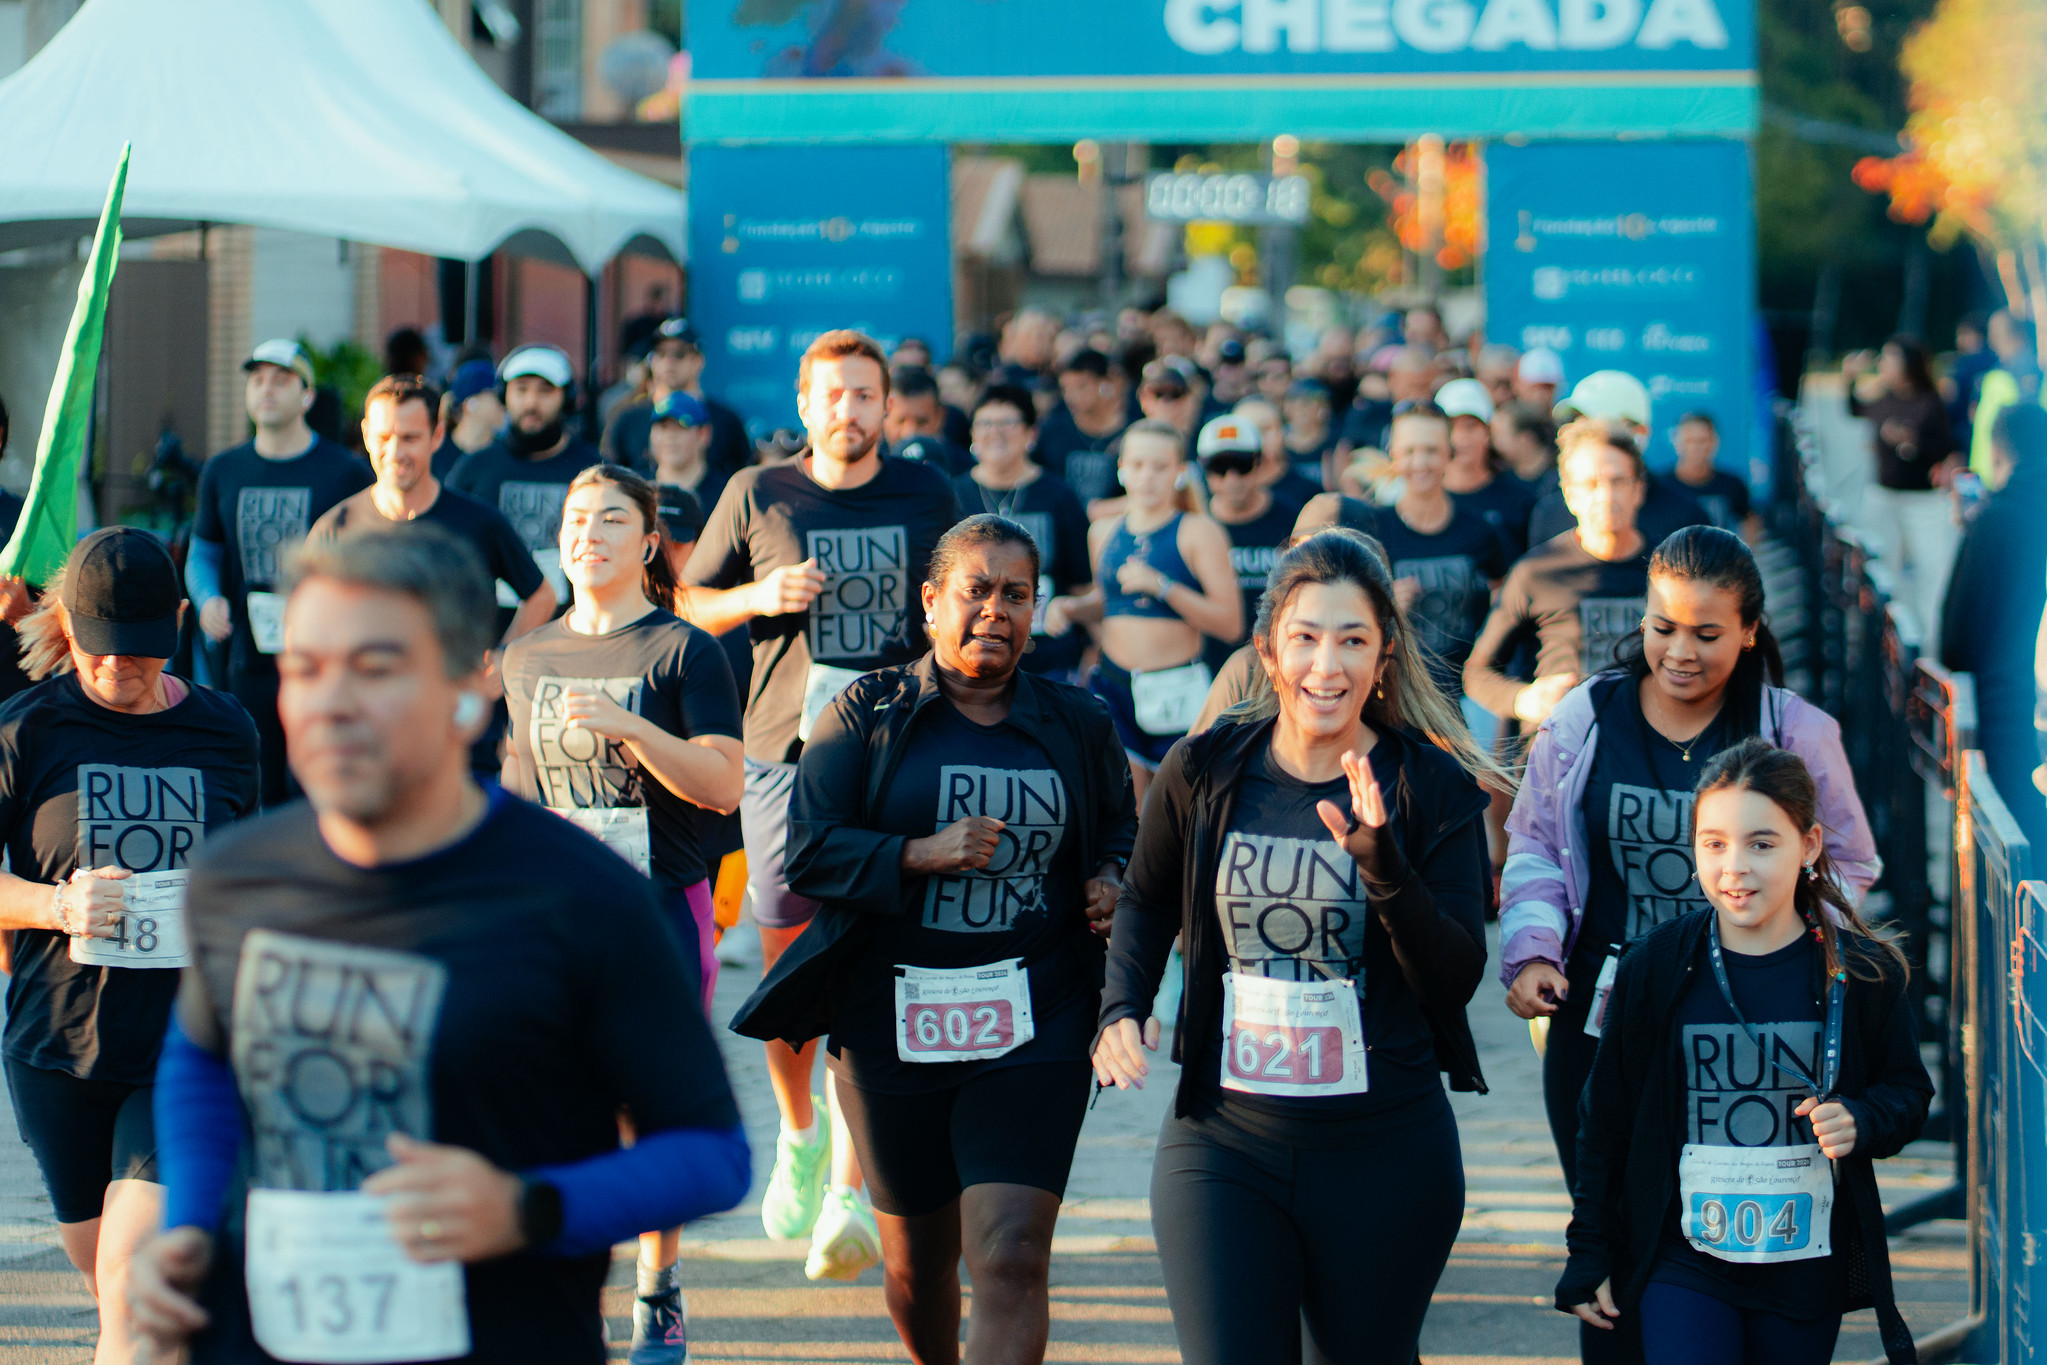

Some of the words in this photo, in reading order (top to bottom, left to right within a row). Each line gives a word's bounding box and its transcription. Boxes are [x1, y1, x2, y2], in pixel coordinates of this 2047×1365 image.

[1163, 0, 1729, 53] CHEGADA
[243, 493, 302, 518] RUN
[815, 533, 900, 574] RUN
[817, 574, 897, 612] FOR
[817, 612, 902, 653] FUN
[87, 771, 198, 821] RUN
[947, 773, 1061, 825] RUN
[1617, 792, 1693, 844] RU
[89, 823, 194, 873] FOR
[976, 828, 1052, 877] OR
[1225, 841, 1357, 900] RUN
[1620, 845, 1695, 896] FO
[931, 874, 1044, 928] FUN
[1226, 901, 1351, 957] FOR
[253, 950, 432, 1052] RUN
[977, 971, 993, 980] TOUR
[1304, 993, 1322, 1002] TOUR
[915, 1005, 1001, 1047] 602
[1235, 1028, 1322, 1079] 621
[1692, 1031, 1821, 1091] RUN
[248, 1041, 410, 1133] FOR
[1697, 1094, 1814, 1147] FOR
[1777, 1159, 1795, 1169] TOUR
[1700, 1199, 1799, 1246] 904
[276, 1272, 399, 1336] 137
